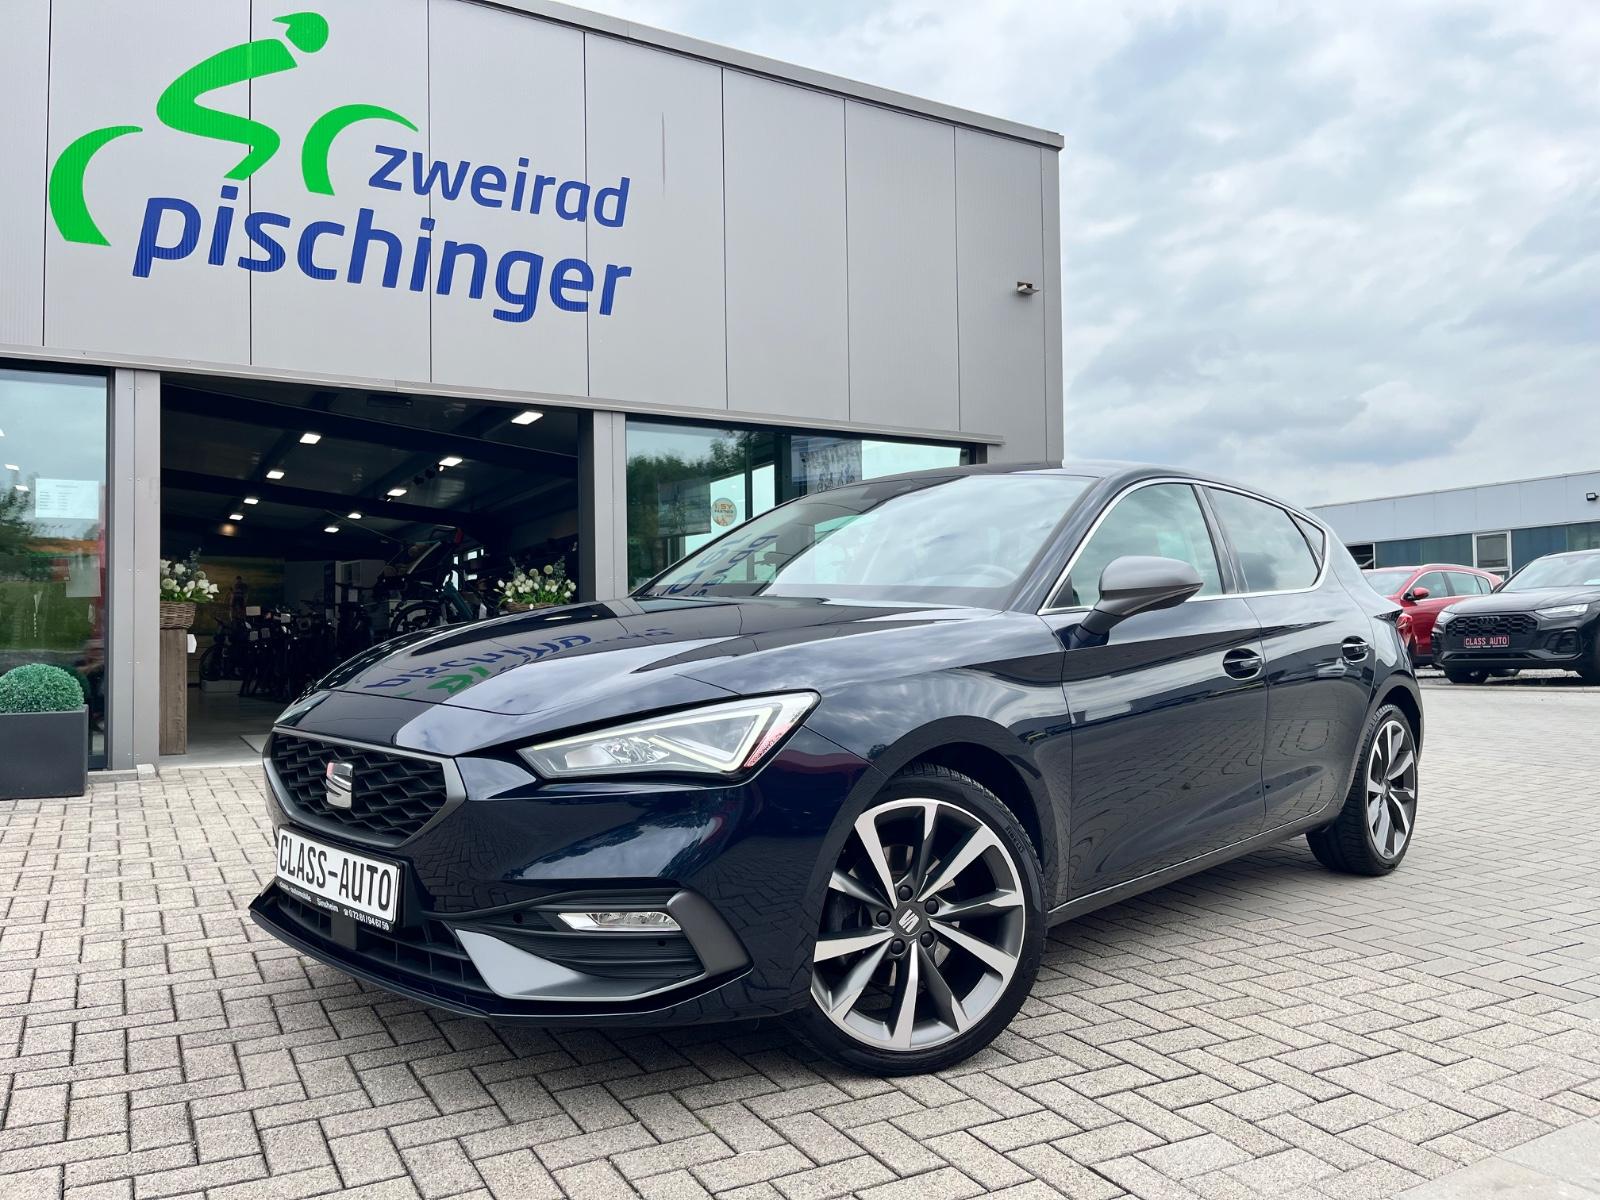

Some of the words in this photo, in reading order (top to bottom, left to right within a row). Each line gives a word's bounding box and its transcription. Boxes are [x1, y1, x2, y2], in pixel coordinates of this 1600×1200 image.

[367, 143, 631, 228] zweirad
[132, 184, 632, 323] pischinger
[1465, 637, 1486, 645] CLASS
[1489, 636, 1507, 644] AUTO
[279, 834, 392, 912] CLASS-AUTO
